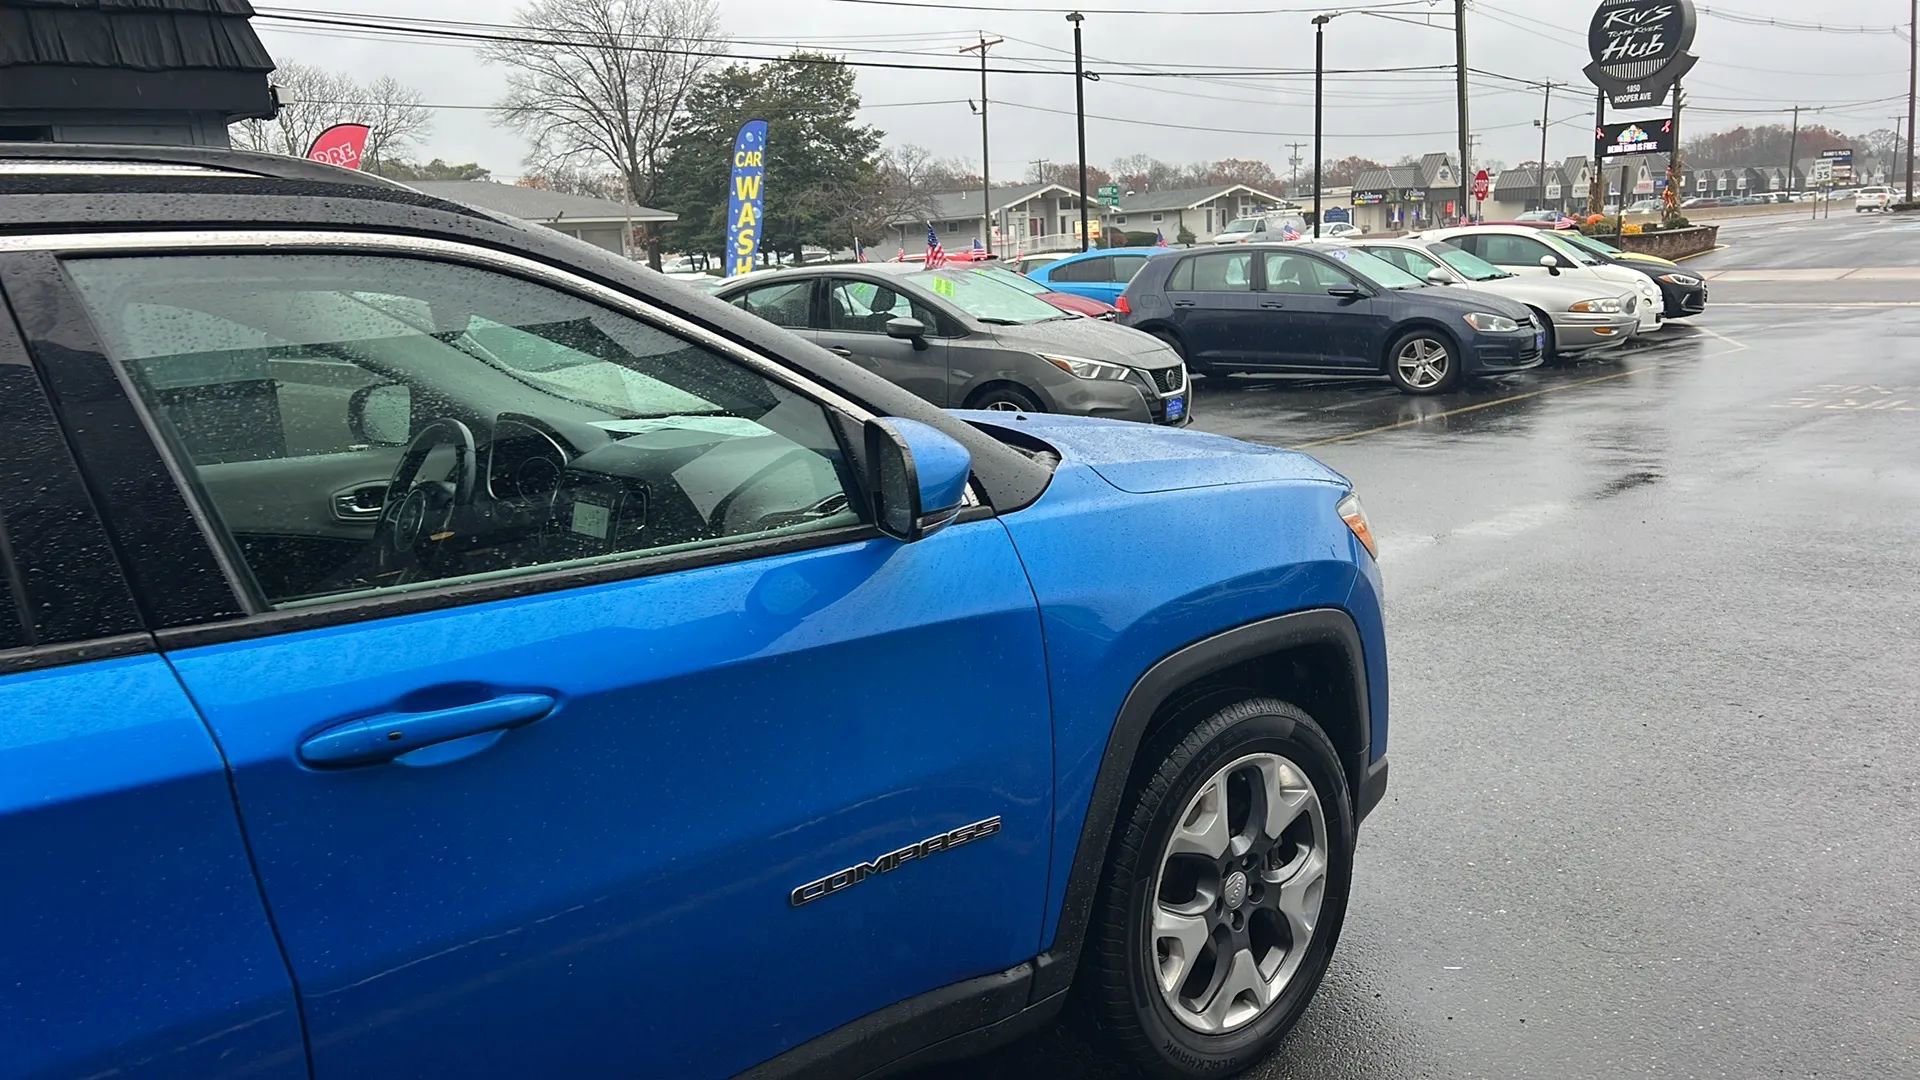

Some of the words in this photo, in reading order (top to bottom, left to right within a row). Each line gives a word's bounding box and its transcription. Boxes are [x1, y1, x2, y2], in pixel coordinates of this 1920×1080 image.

[1632, 24, 1664, 35] RIVER
[1626, 84, 1641, 93] 1850
[1614, 94, 1639, 104] HOOPER
[1639, 93, 1652, 101] AVE
[735, 151, 762, 168] CAR
[1816, 171, 1830, 180] 35
[1474, 179, 1488, 192] STOP
[735, 175, 761, 275] WASH
[791, 815, 1002, 907] COMPASS
[1163, 1039, 1238, 1072] BLACKHAWK
